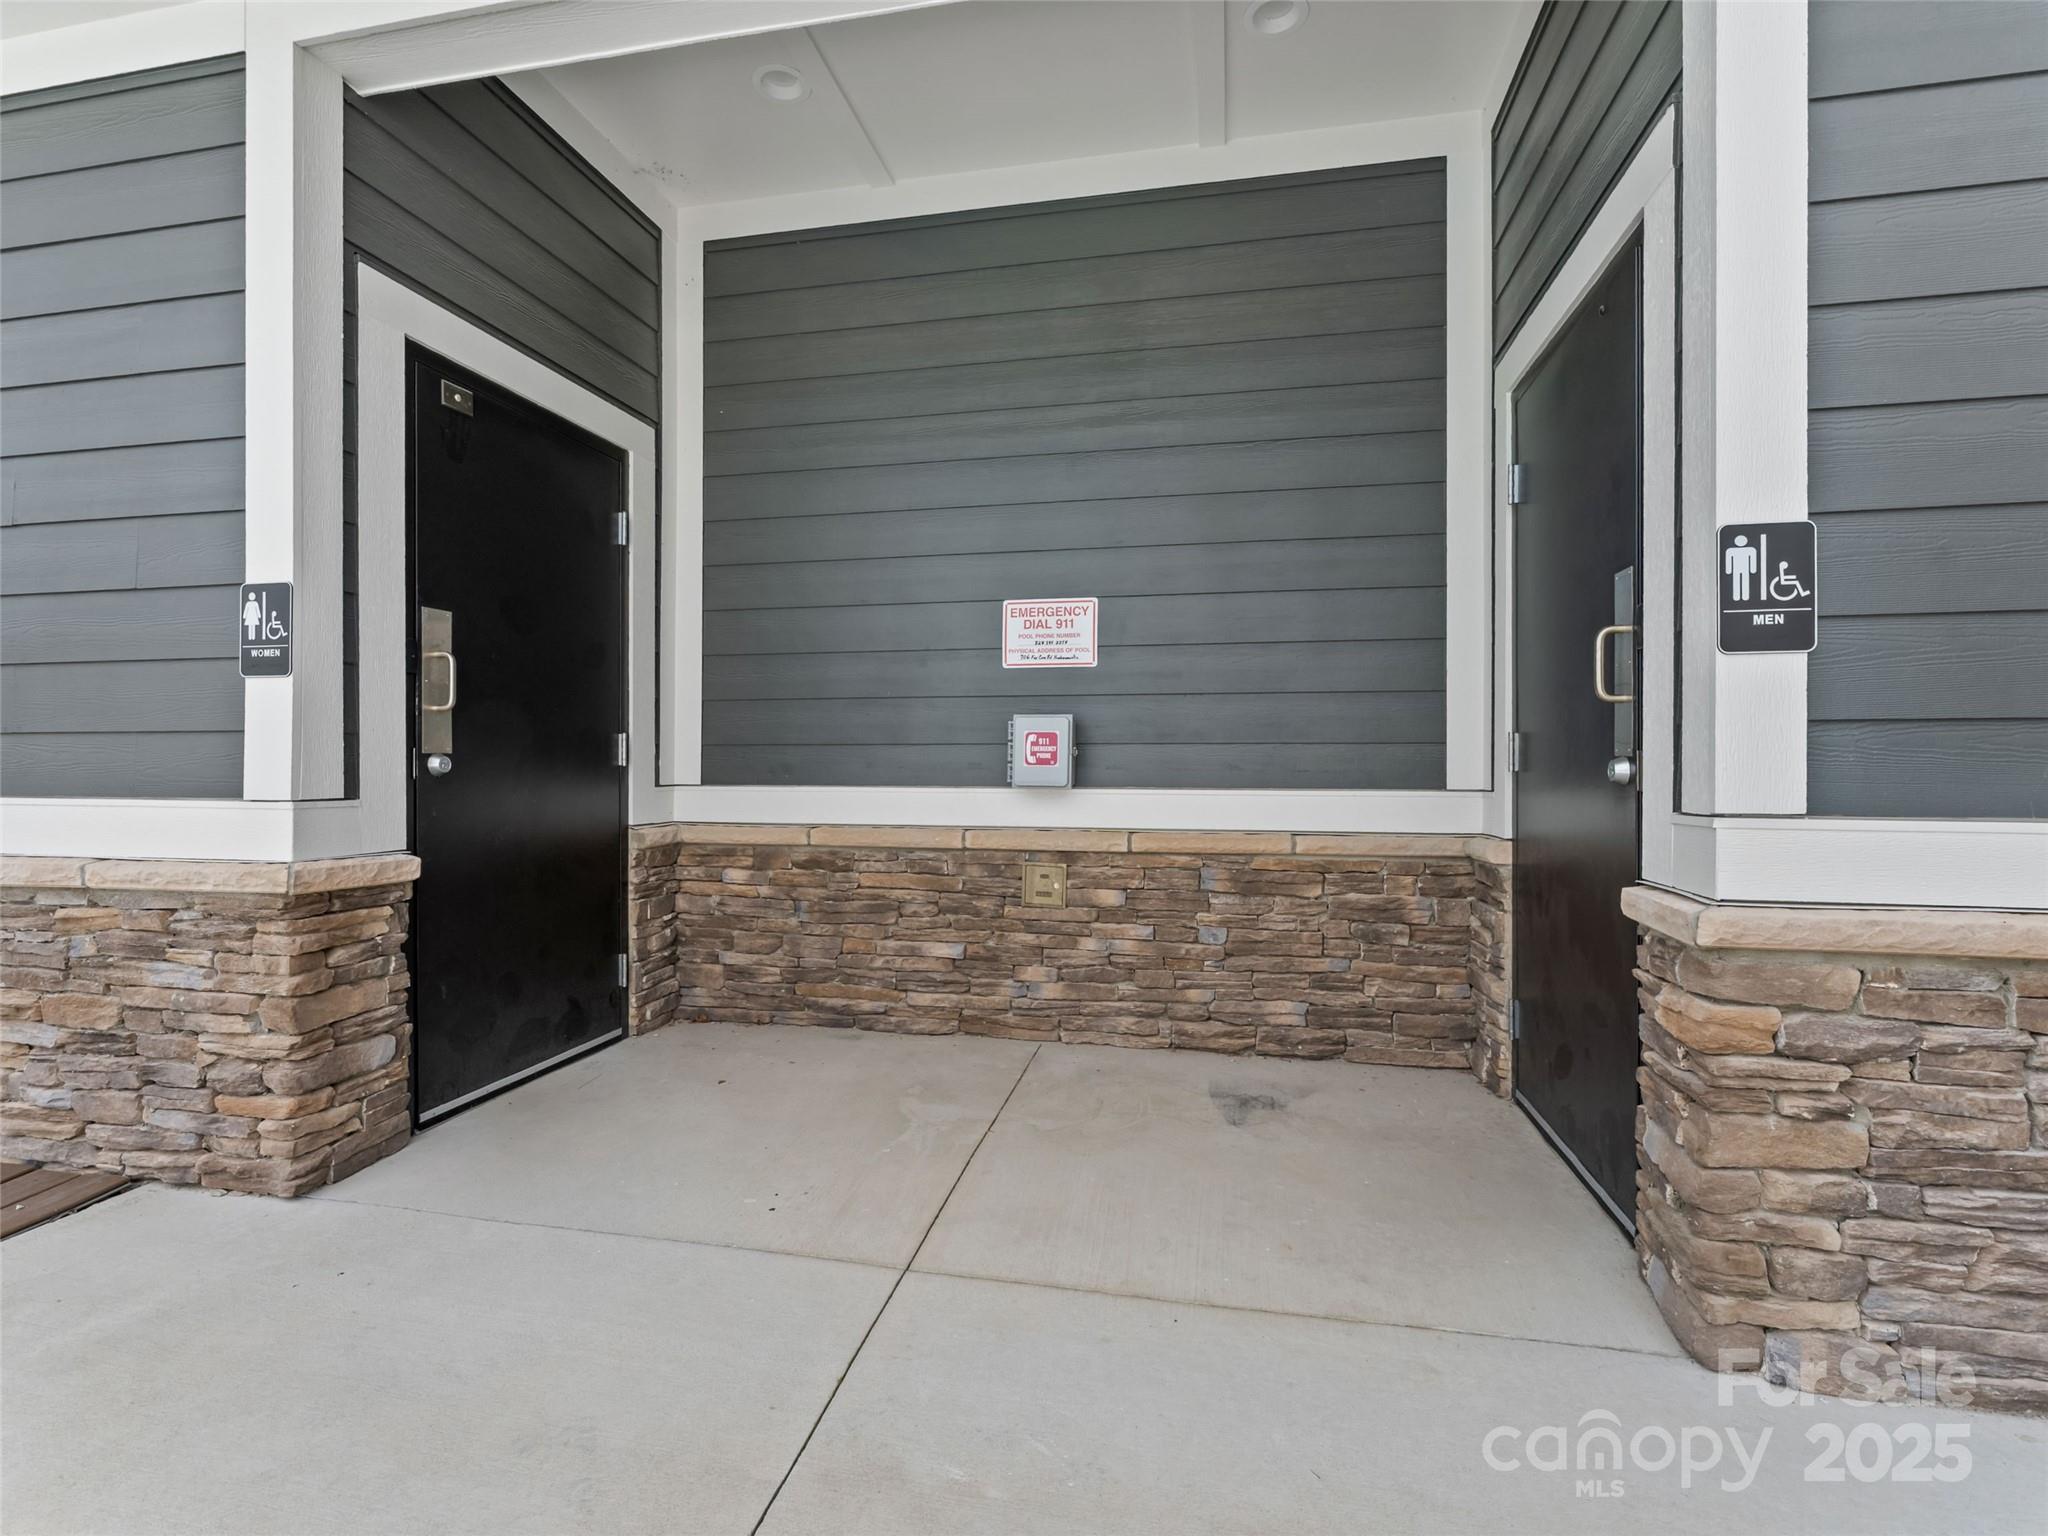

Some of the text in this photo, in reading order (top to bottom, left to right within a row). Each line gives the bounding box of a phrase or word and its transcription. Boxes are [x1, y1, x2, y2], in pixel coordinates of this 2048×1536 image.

[1010, 606, 1090, 618] EMERGENCY
[1023, 618, 1074, 630] DIAL 911
[1753, 613, 1785, 625] MEN
[250, 649, 281, 658] WOMEN
[1009, 647, 1036, 655] PHYSICAL
[1038, 737, 1049, 745] 911
